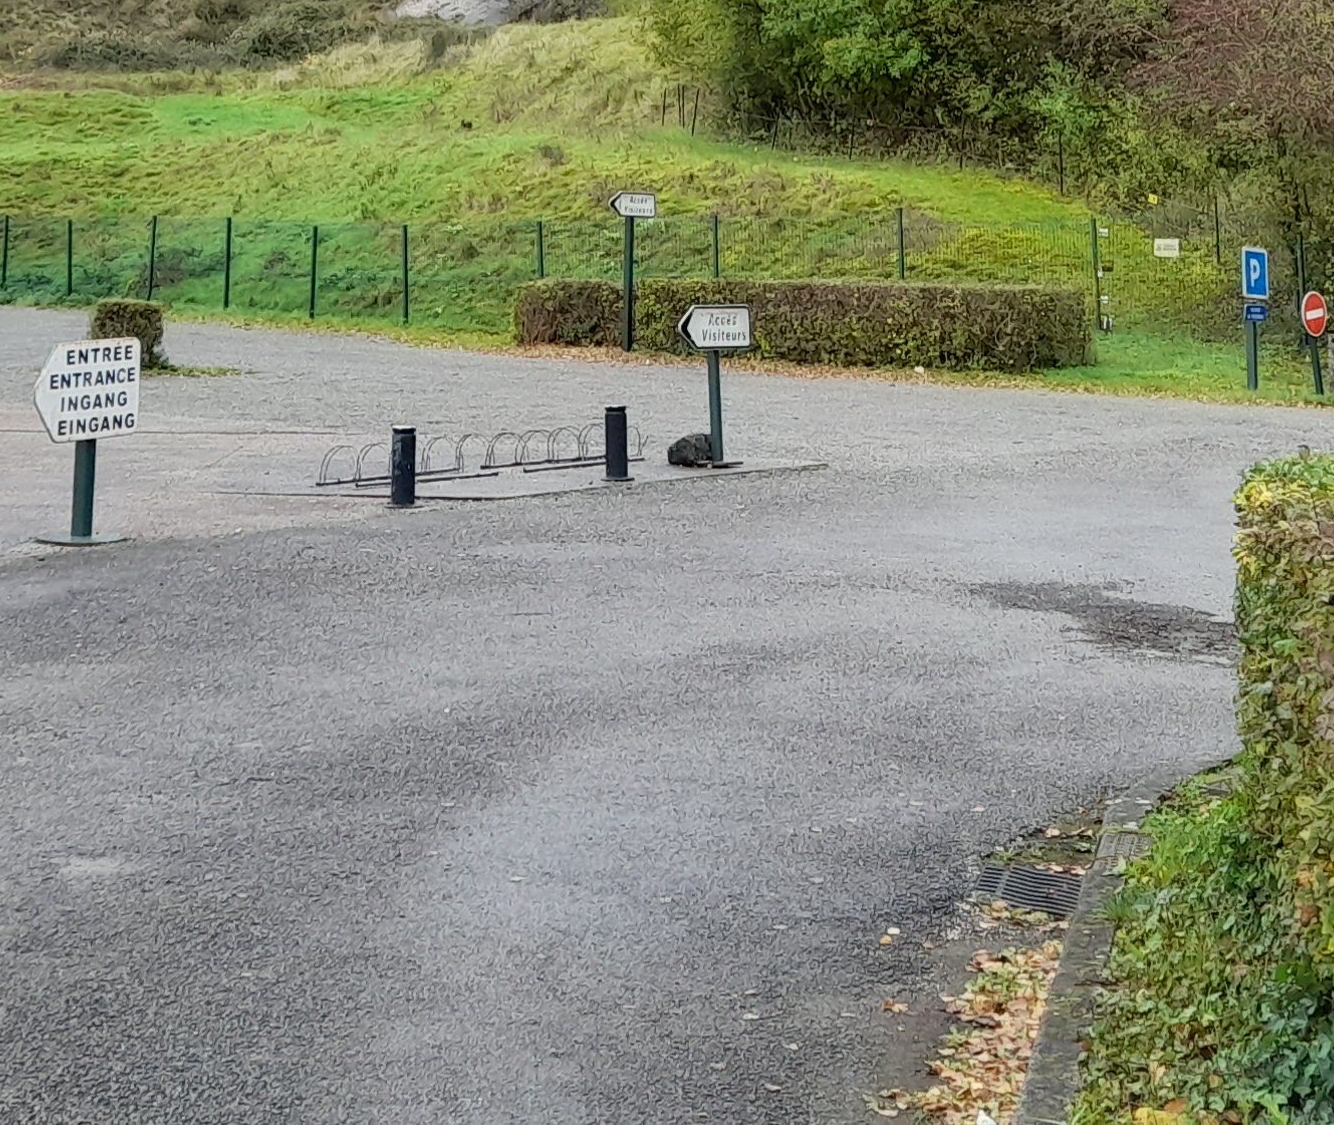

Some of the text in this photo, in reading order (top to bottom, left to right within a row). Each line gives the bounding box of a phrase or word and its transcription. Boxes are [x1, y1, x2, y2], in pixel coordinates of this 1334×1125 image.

[1250, 258, 1260, 287] P
[708, 313, 737, 326] Accès
[701, 328, 746, 342] Visiteurs
[49, 367, 136, 390] ENTRANCE
[60, 391, 128, 413] INGANG
[57, 413, 135, 436] EINGANG
